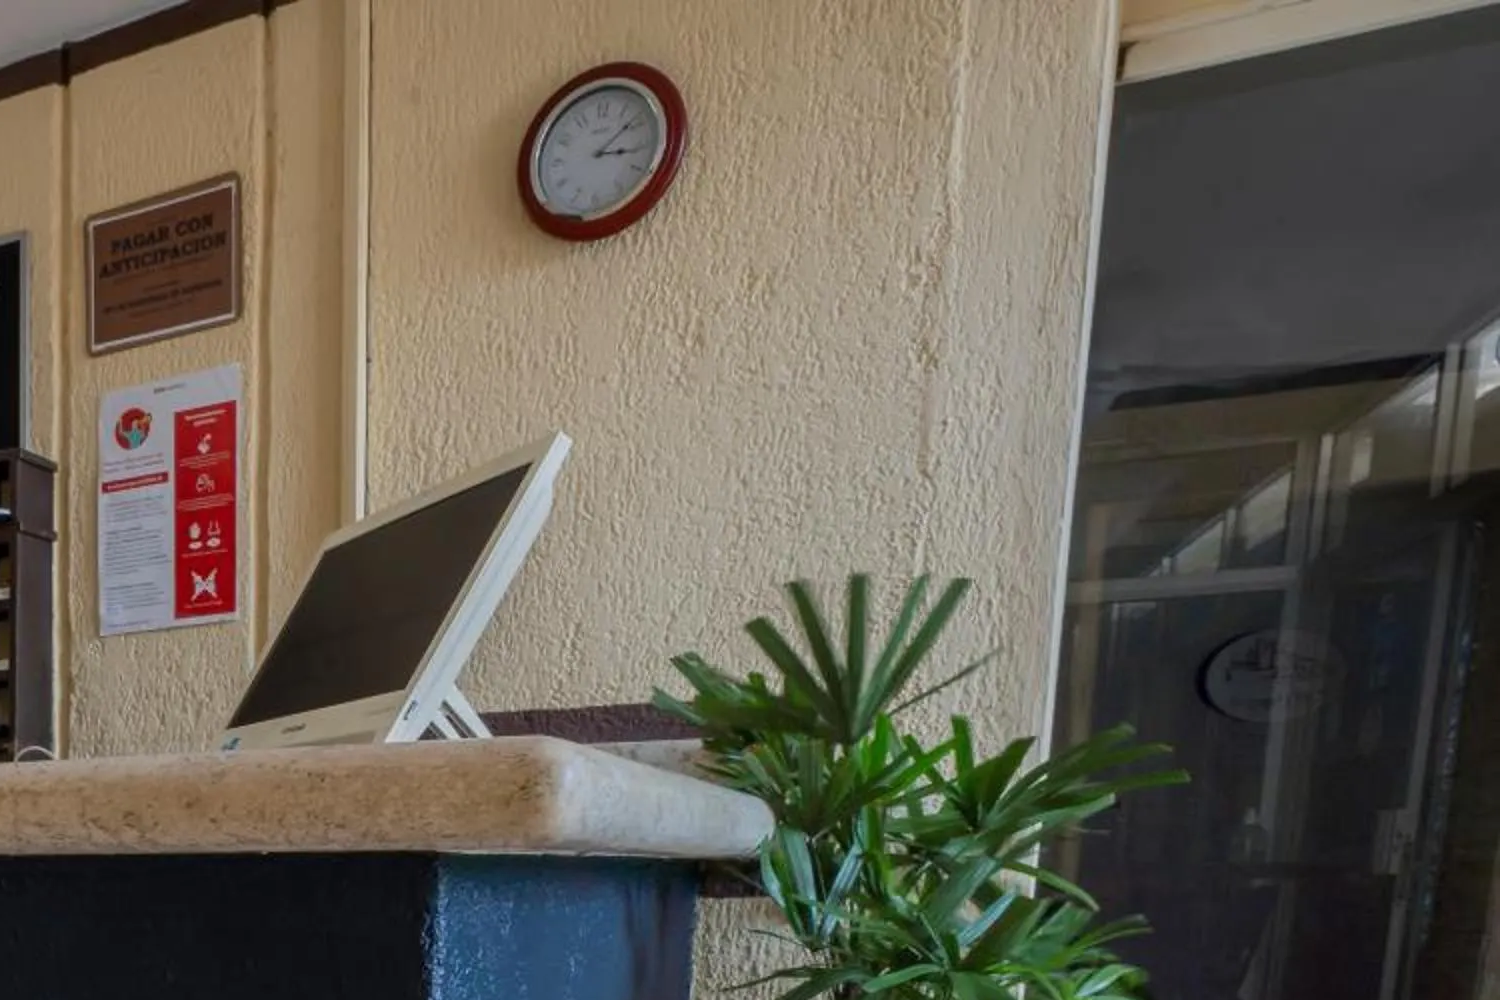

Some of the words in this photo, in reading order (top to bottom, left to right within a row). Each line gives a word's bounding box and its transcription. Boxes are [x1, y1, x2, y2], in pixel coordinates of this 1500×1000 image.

[99, 230, 227, 279] ANTICIPACION
[110, 225, 170, 255] PAGAR
[175, 213, 214, 238] CON
